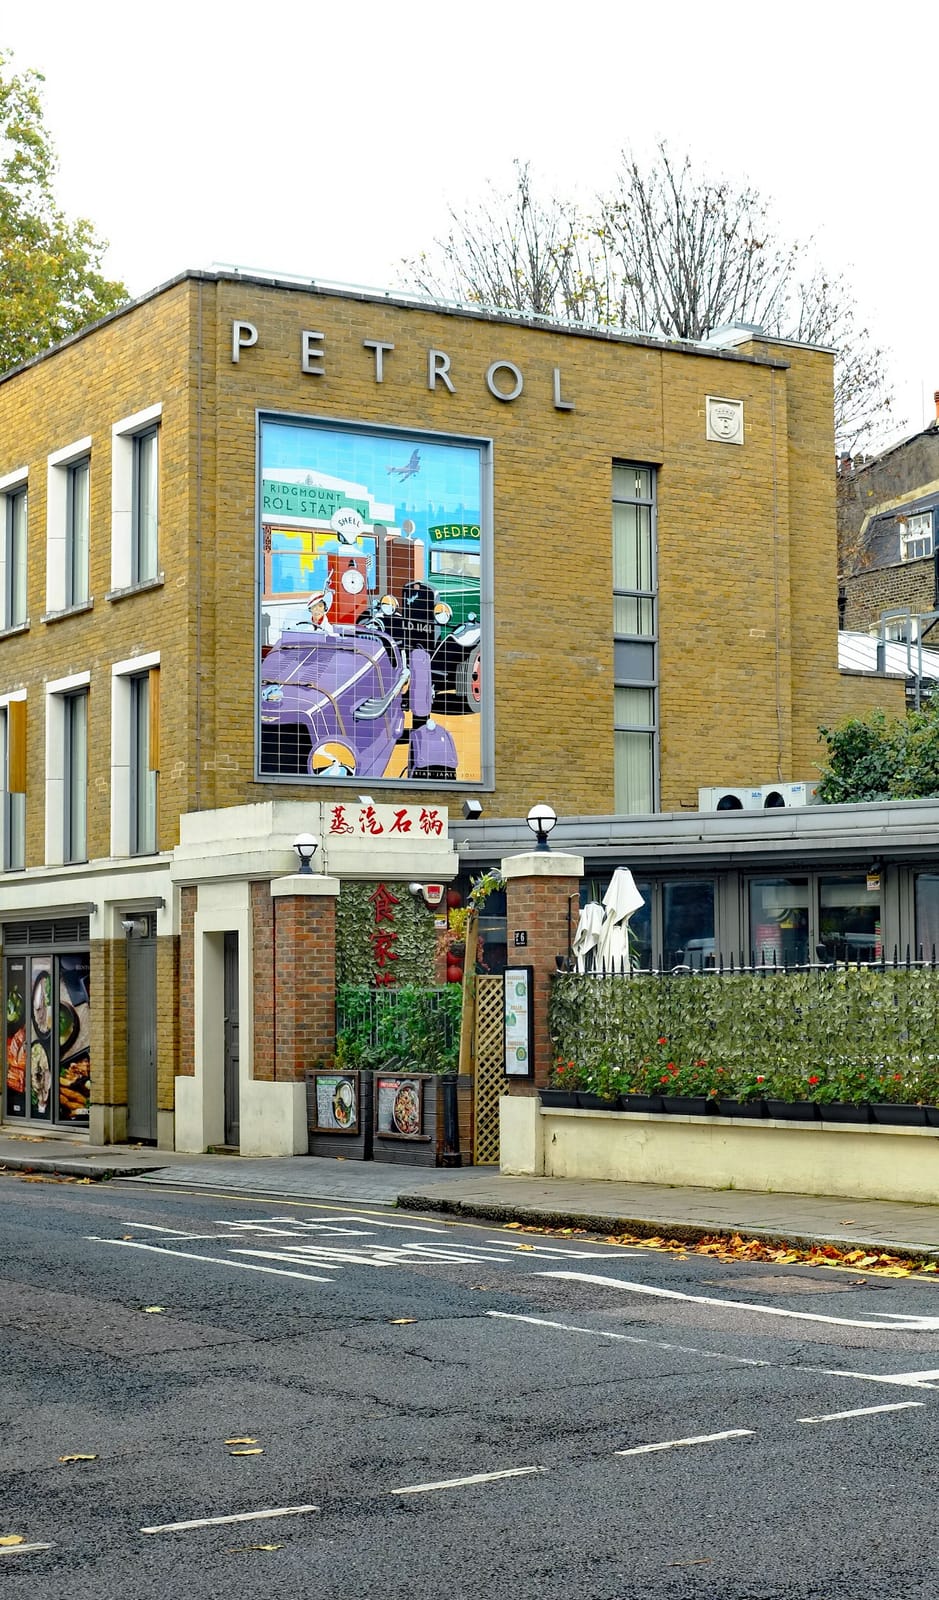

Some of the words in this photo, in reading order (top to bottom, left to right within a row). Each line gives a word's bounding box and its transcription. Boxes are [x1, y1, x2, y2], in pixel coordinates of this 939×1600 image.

[231, 320, 576, 410] PETROL
[270, 484, 341, 501] RIDGMOUNT
[301, 501, 366, 519] STATN
[338, 516, 361, 528] SHELL
[434, 526, 480, 540] BEDFO
[402, 620, 414, 631] LD
[416, 623, 432, 633] 1141
[328, 805, 444, 836] 蒸汽石锅
[228, 1240, 649, 1269] TURN
